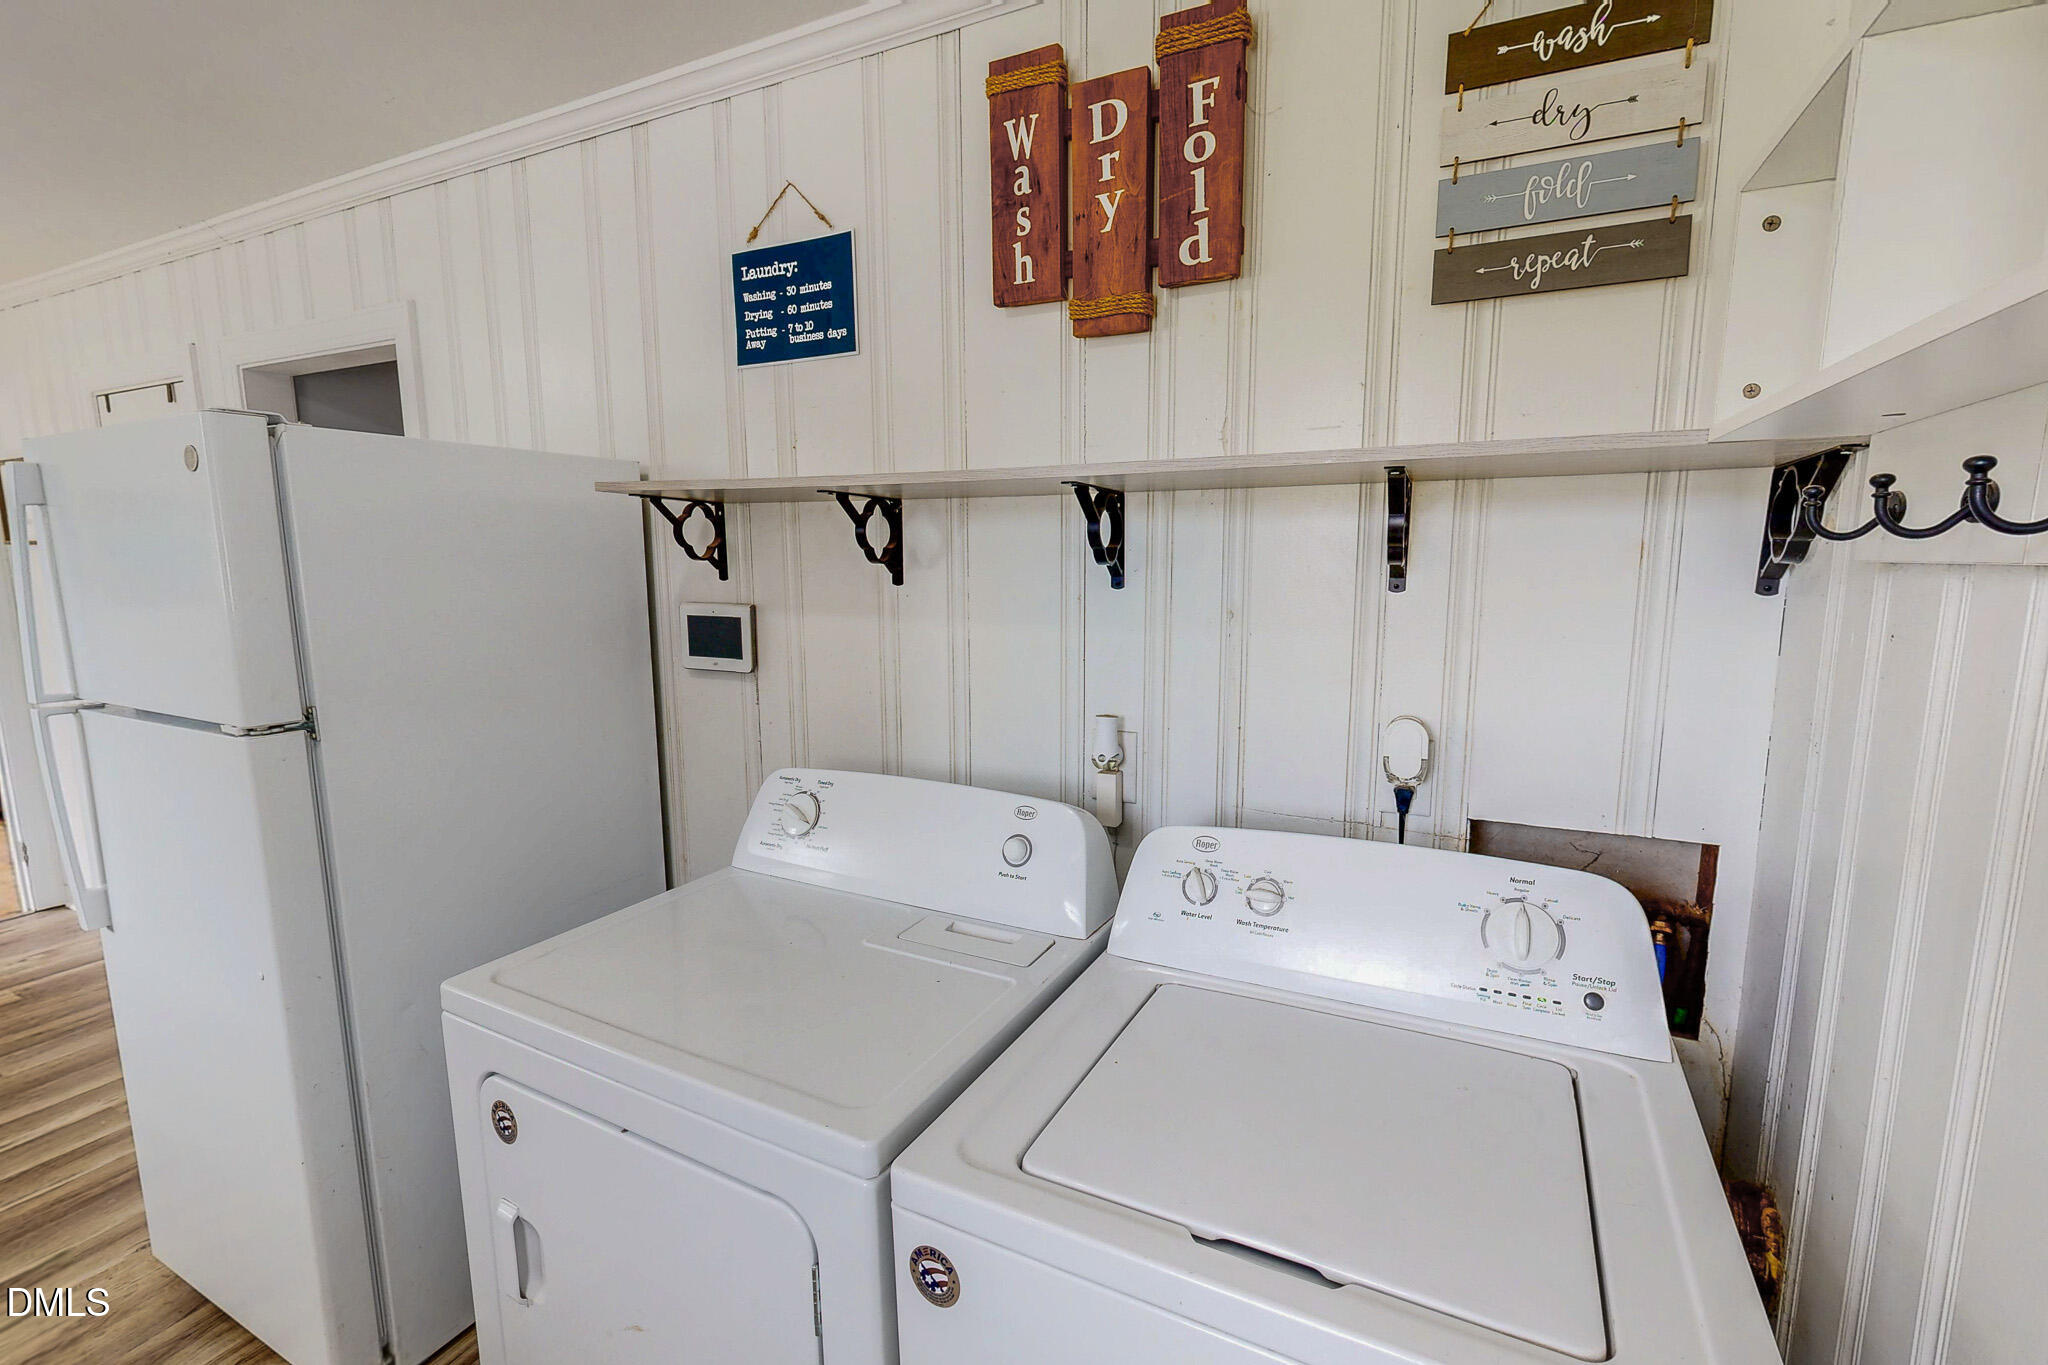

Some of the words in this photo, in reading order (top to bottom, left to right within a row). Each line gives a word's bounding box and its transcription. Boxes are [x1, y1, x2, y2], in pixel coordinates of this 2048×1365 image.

[1533, 0, 1613, 61] wash
[1532, 88, 1592, 140] dry
[1087, 98, 1128, 233] Dry
[1178, 75, 1221, 266] Fold
[1003, 113, 1039, 285] Wash
[1523, 160, 1593, 220] fold
[740, 261, 798, 281] Laundry:
[1509, 234, 1597, 289] repeat
[743, 290, 777, 303] Washing
[786, 286, 796, 296] 30
[800, 281, 832, 294] minutes
[744, 310, 773, 322] Drying
[787, 305, 797, 315] 60
[800, 300, 833, 313] minutes
[745, 327, 777, 339] Putting
[788, 324, 793, 333] 7
[794, 323, 803, 332] to
[805, 321, 814, 331] 10
[746, 339, 767, 350] Away
[789, 331, 824, 344] business
[827, 328, 847, 339] days
[1016, 808, 1035, 818] Roper
[1196, 839, 1218, 850] Roper
[1509, 877, 1536, 886] Normal
[1197, 911, 1212, 920] Level
[1236, 919, 1252, 927] Wash
[1252, 921, 1289, 933] Temperature
[1572, 973, 1616, 987] Start/Stop
[911, 1247, 954, 1275] AMERICA
